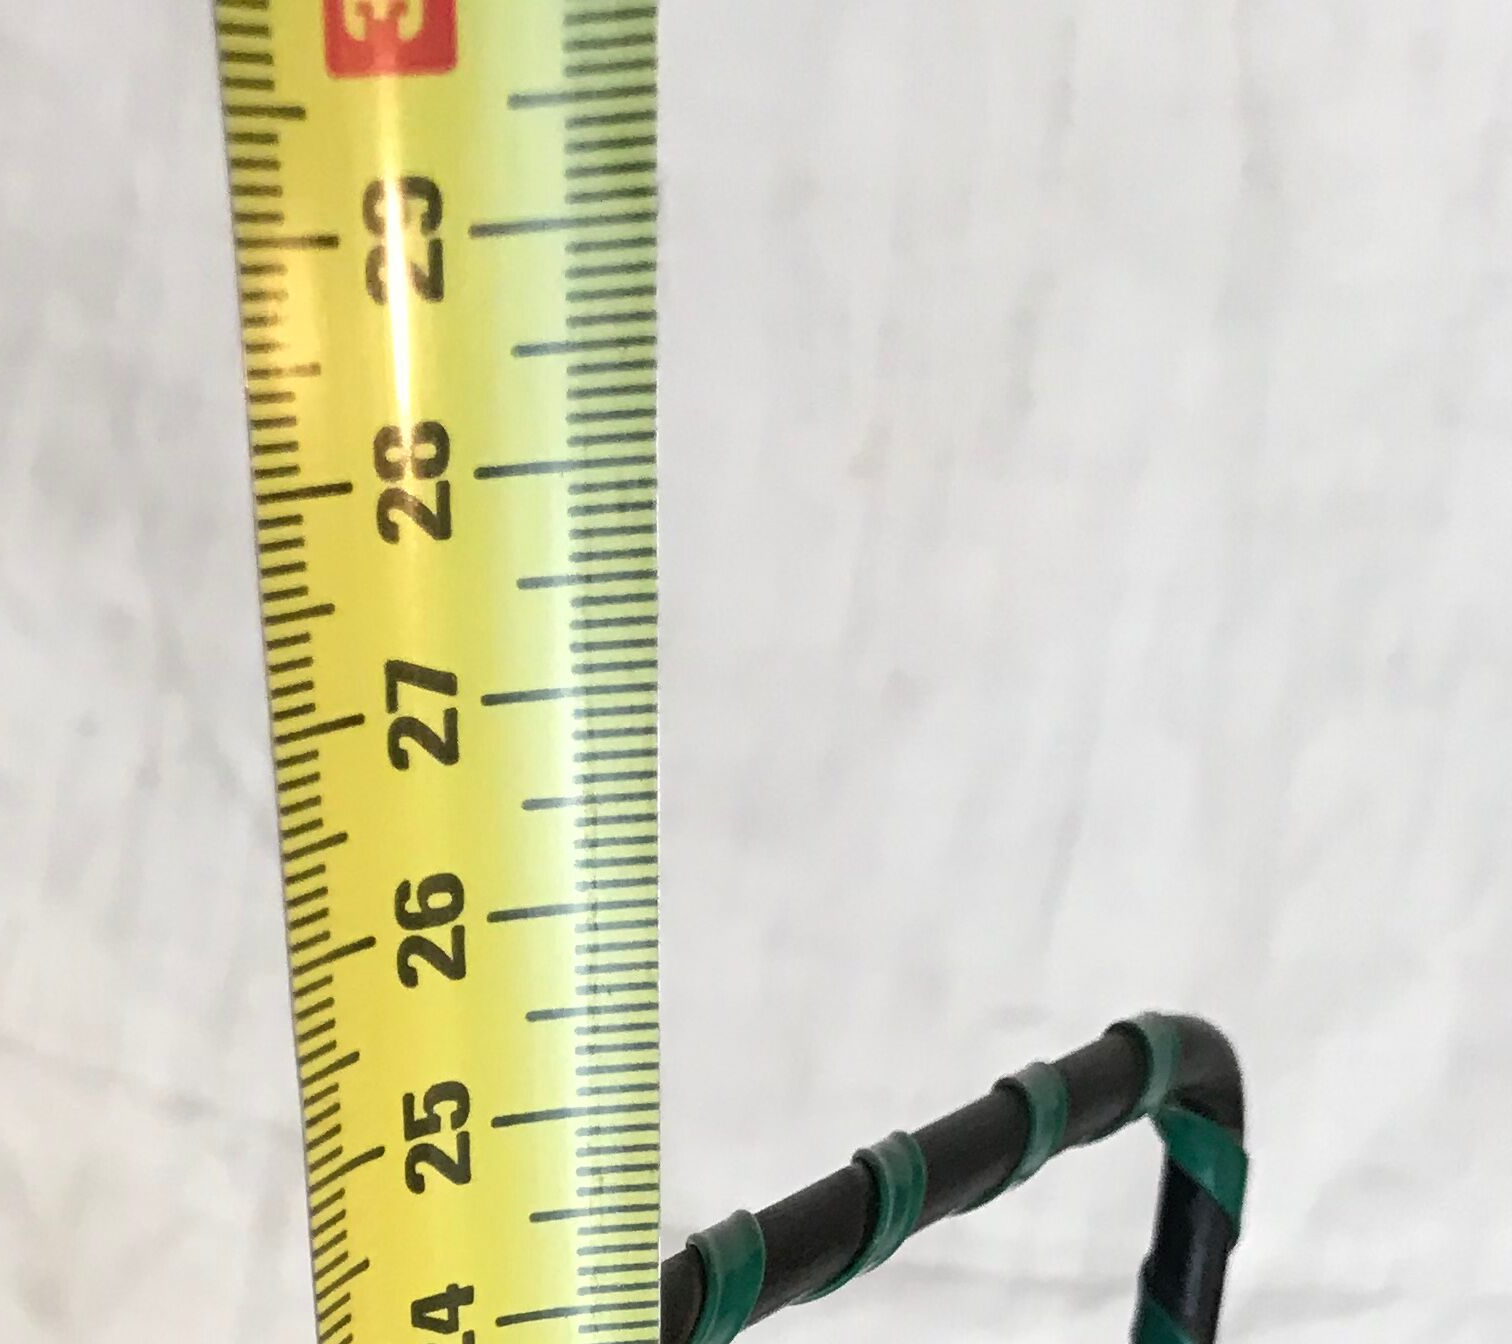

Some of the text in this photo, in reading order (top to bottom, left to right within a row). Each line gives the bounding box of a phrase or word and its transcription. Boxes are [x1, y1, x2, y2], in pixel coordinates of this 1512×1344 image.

[343, 0, 427, 42] 3
[373, 420, 452, 544] 28
[384, 659, 460, 771] 27
[395, 872, 467, 988] 26
[403, 1080, 472, 1194] 25
